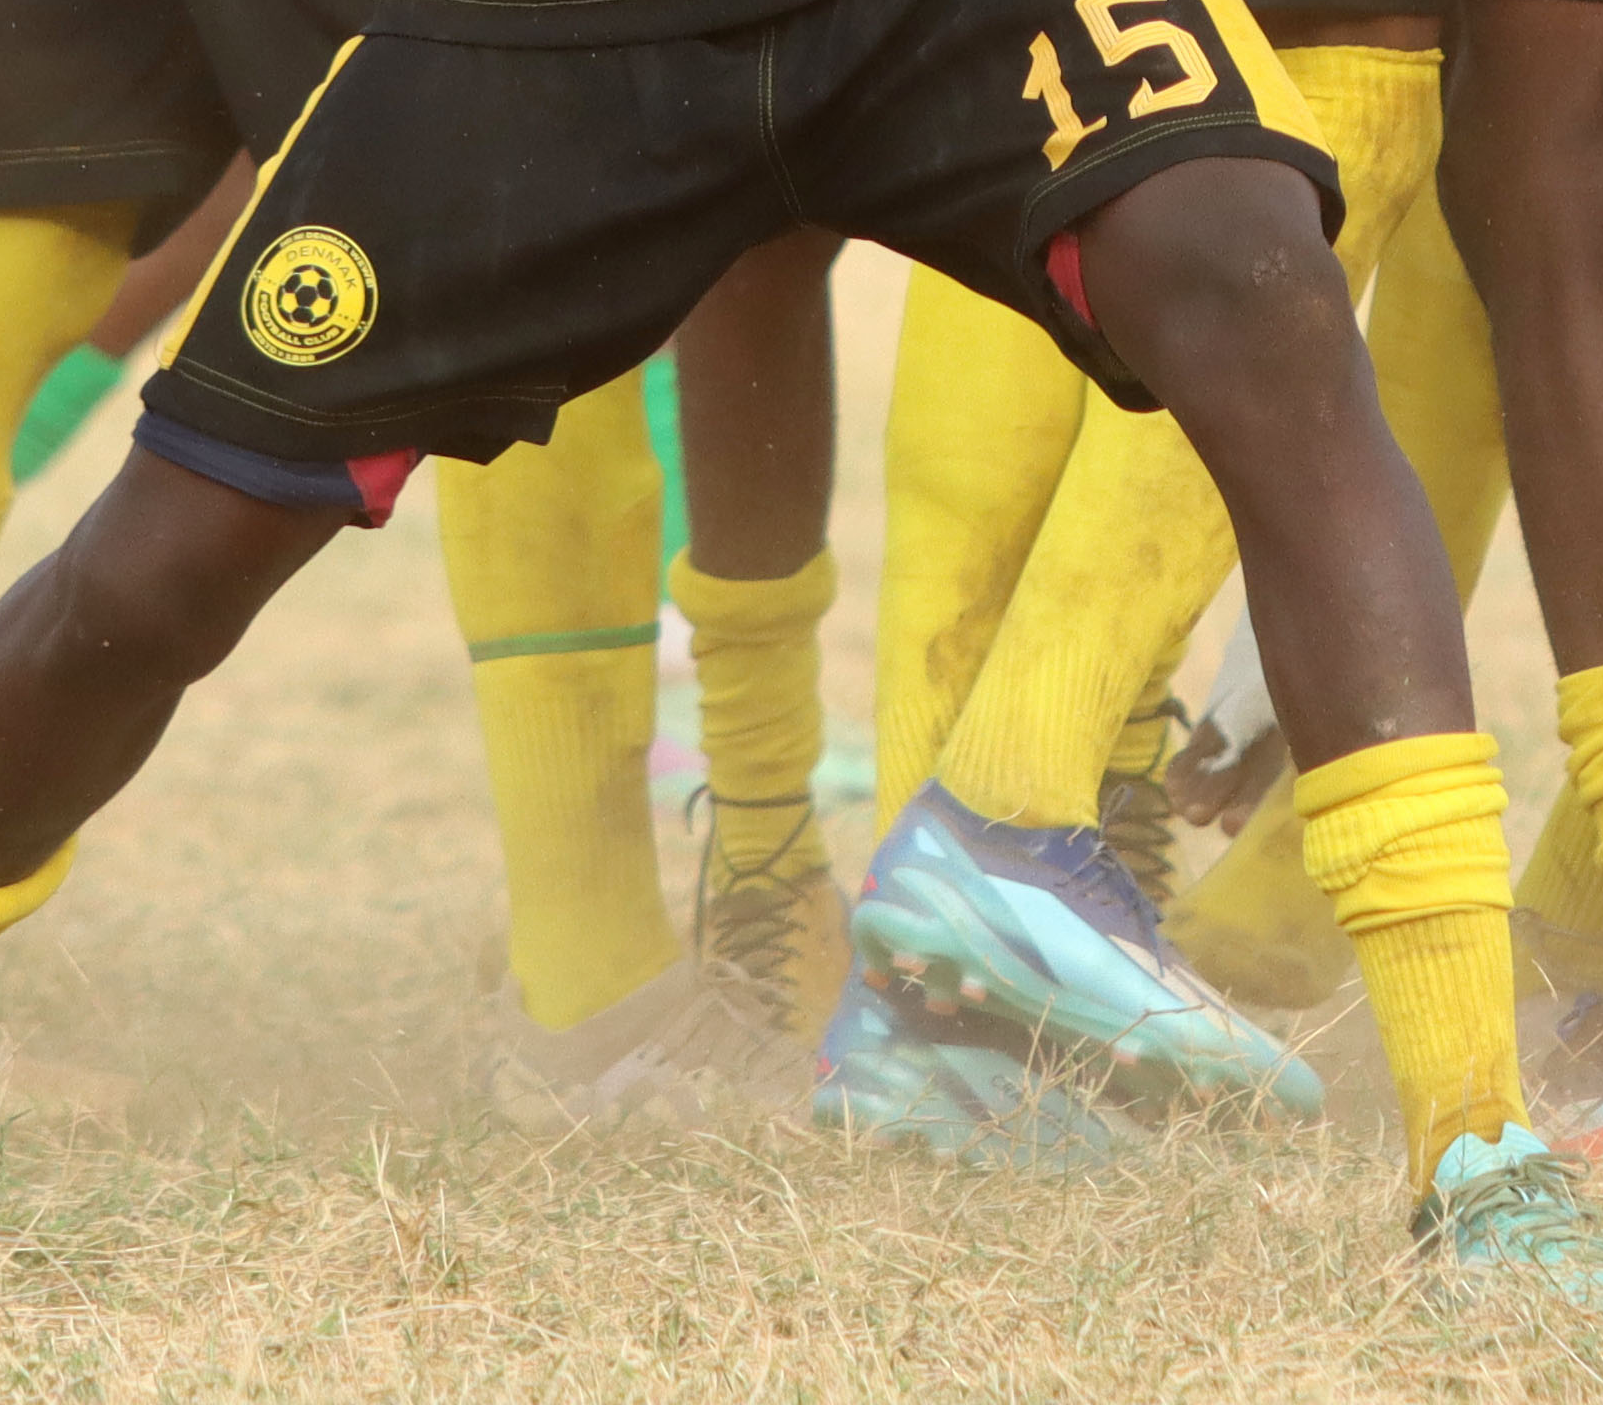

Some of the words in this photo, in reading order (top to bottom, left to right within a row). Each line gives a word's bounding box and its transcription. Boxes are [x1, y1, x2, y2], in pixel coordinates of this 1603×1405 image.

[285, 244, 357, 291] DENMAK
[259, 292, 302, 346] FOOTBALL
[303, 325, 341, 347] CLUB
